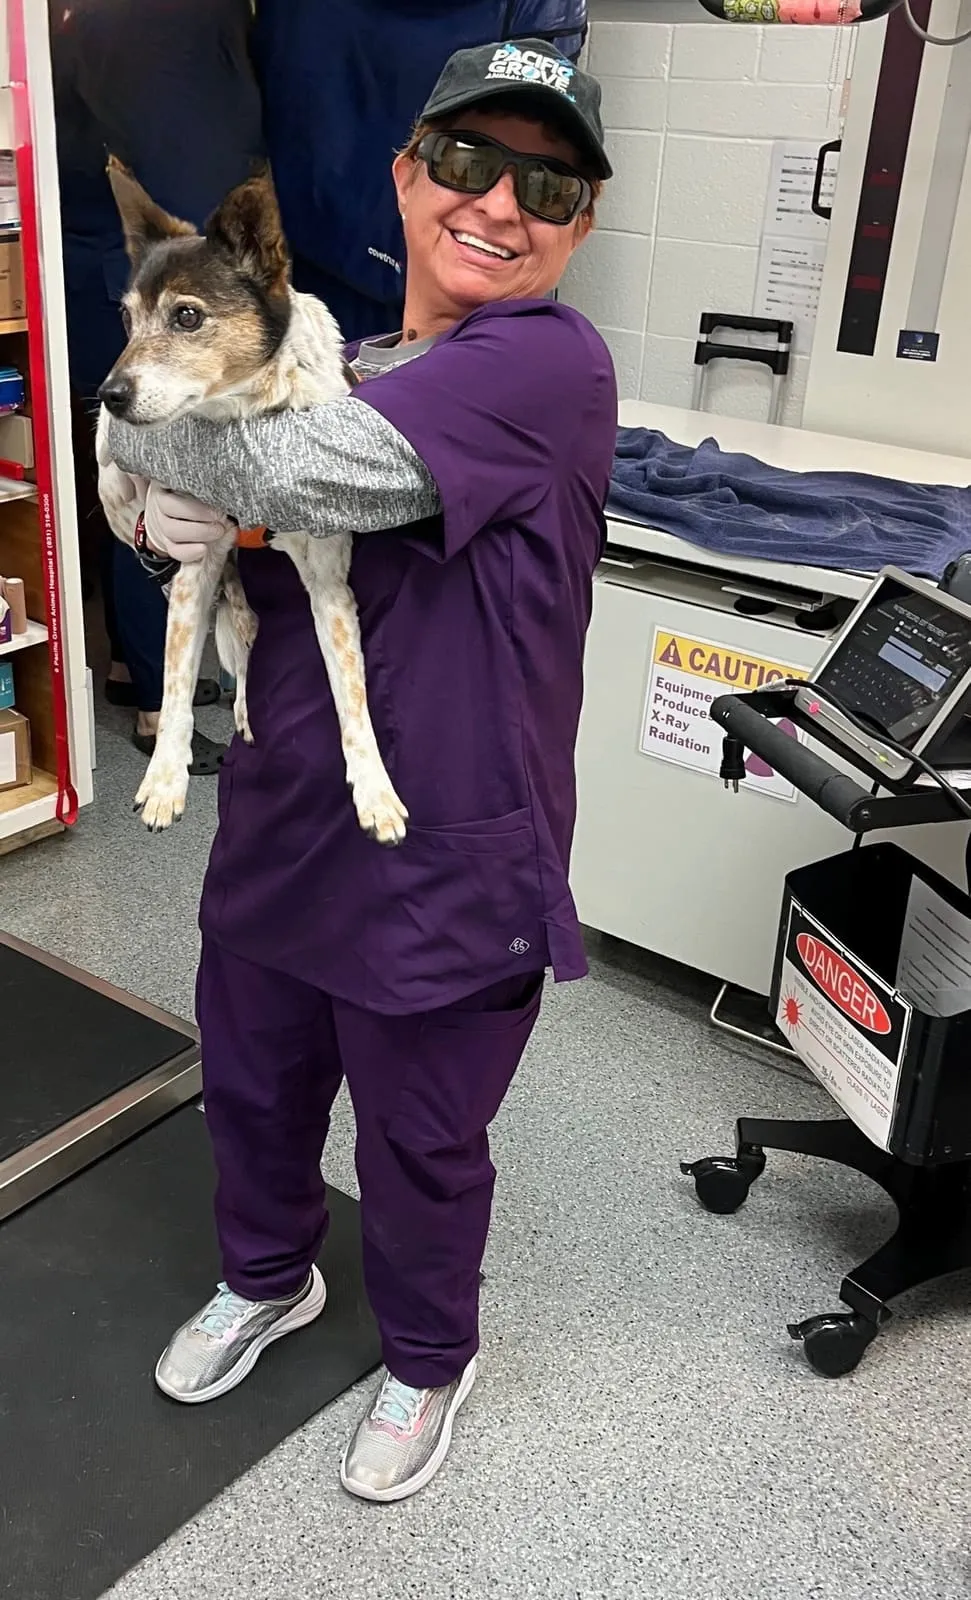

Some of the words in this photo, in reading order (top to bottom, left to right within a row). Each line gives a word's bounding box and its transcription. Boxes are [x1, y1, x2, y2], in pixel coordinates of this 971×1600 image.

[488, 61, 570, 88] GROVE
[492, 48, 574, 78] PACIFIC
[47, 558, 55, 590] Hospital
[656, 676, 716, 704] Equipme
[651, 709, 690, 732] X-Ray
[648, 726, 711, 754] Radiation
[804, 936, 876, 1029] DANGER
[883, 1077, 892, 1090] TO
